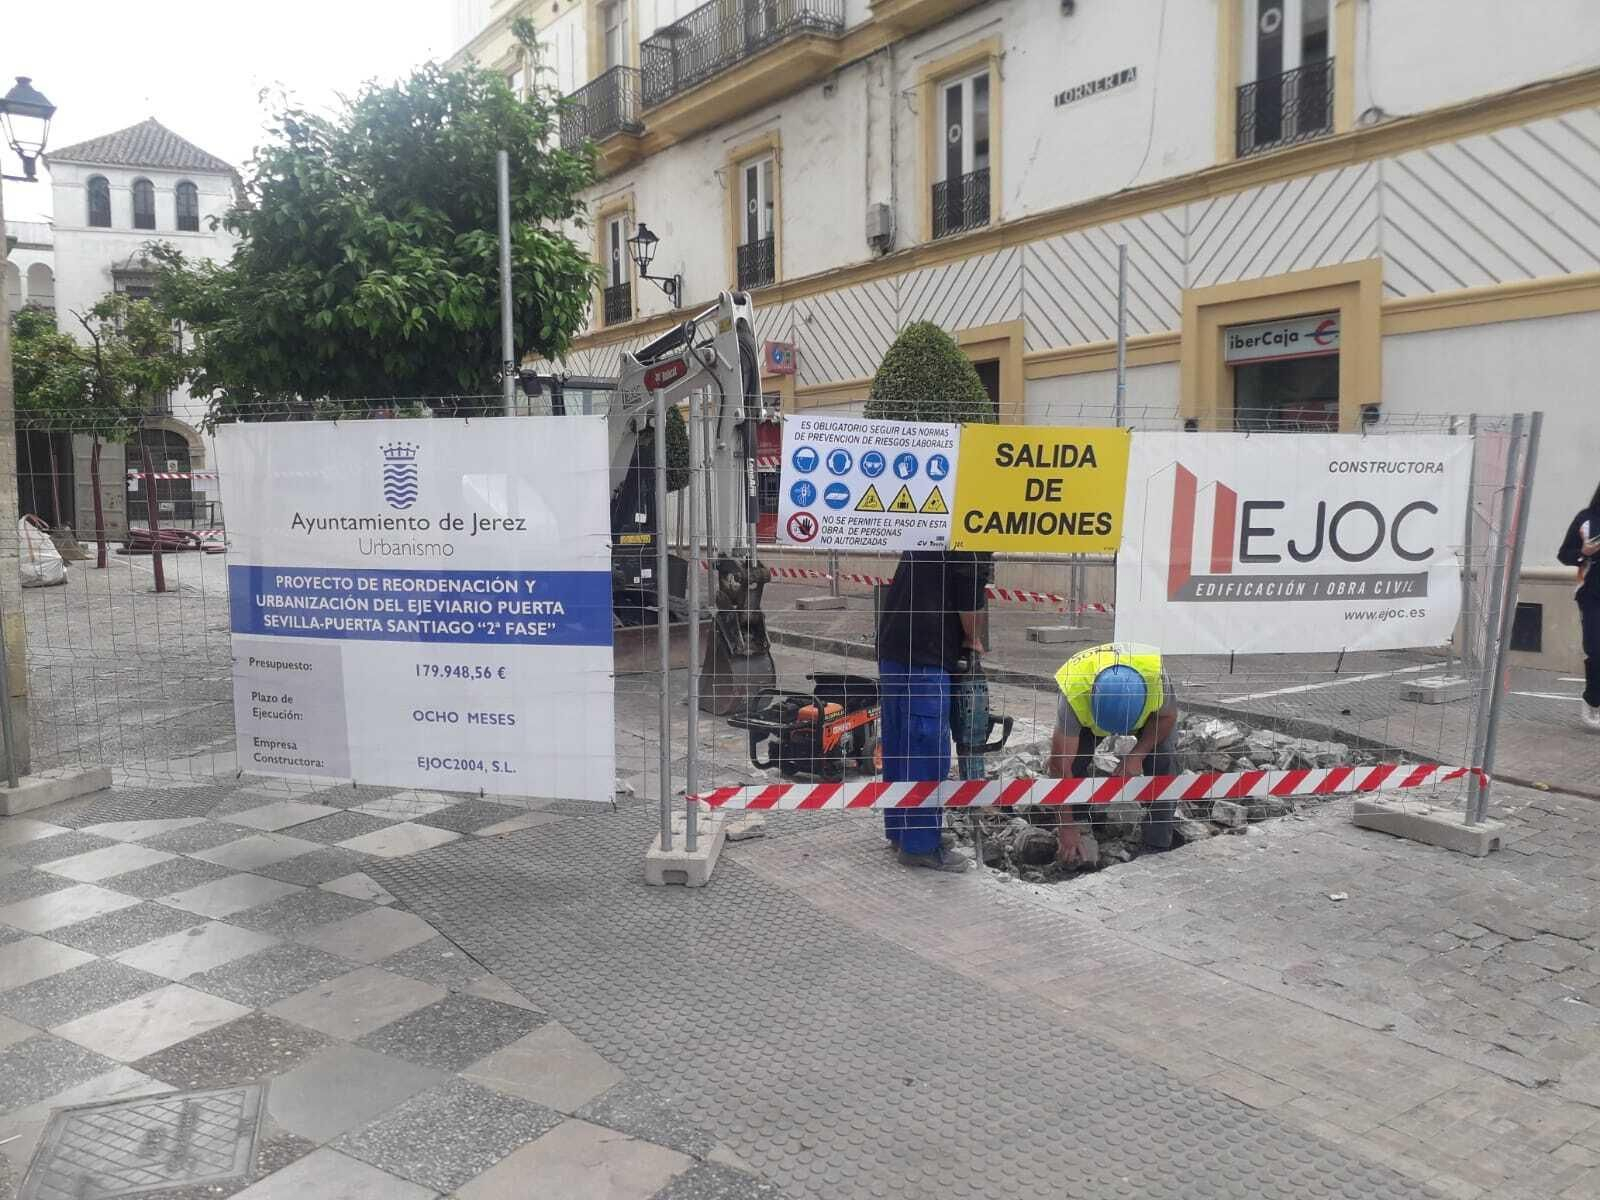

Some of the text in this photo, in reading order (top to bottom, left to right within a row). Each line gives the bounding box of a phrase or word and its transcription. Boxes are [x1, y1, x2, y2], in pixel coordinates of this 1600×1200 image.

[1229, 329, 1299, 350] iberCaja
[801, 421, 949, 438] ES OBLIGATORIO SEGUIR LAS NORMAS
[794, 432, 954, 449] DE PREVENCION DE RIESGOS LABORALES
[995, 442, 1098, 469] SALIDA
[1328, 461, 1445, 474] CONSTRUCTORA
[1025, 478, 1064, 502] DE
[291, 511, 527, 536] Ayuntamiento de Jerez
[822, 516, 947, 529] NO SE PERMITE EL PASO EN ESTA
[963, 510, 1113, 536] CAMIONES
[821, 526, 844, 535] OBRA
[860, 528, 902, 537] PERSONAS
[1239, 500, 1439, 564] EJOC
[358, 538, 454, 557] Urbanismo
[820, 537, 887, 546] NO AUTORIZADAS
[276, 576, 536, 594] PROYECTO DE REORDENACIÓN Y
[1196, 580, 1306, 597] EDIFICACIÓN
[1327, 582, 1367, 596] OBRA
[1374, 580, 1416, 595] CIVIL
[256, 594, 565, 616] URBANIZACIÓN DEL EJE VIARIO PUERTA
[1344, 608, 1426, 622] www.ejoc.es
[263, 614, 384, 632] SEVILLA-PUERTA
[387, 619, 475, 635] SANTIAGO
[248, 656, 313, 672] Presupuesto:
[416, 663, 506, 680] 179.948,56 €
[251, 691, 294, 704] Plazo de
[252, 707, 304, 720] Ejecución:
[412, 709, 516, 726] OCHO MESES
[253, 737, 297, 750] Empresa
[253, 752, 325, 768] Constructora:
[417, 756, 517, 774] EJOC2004, S.L.
